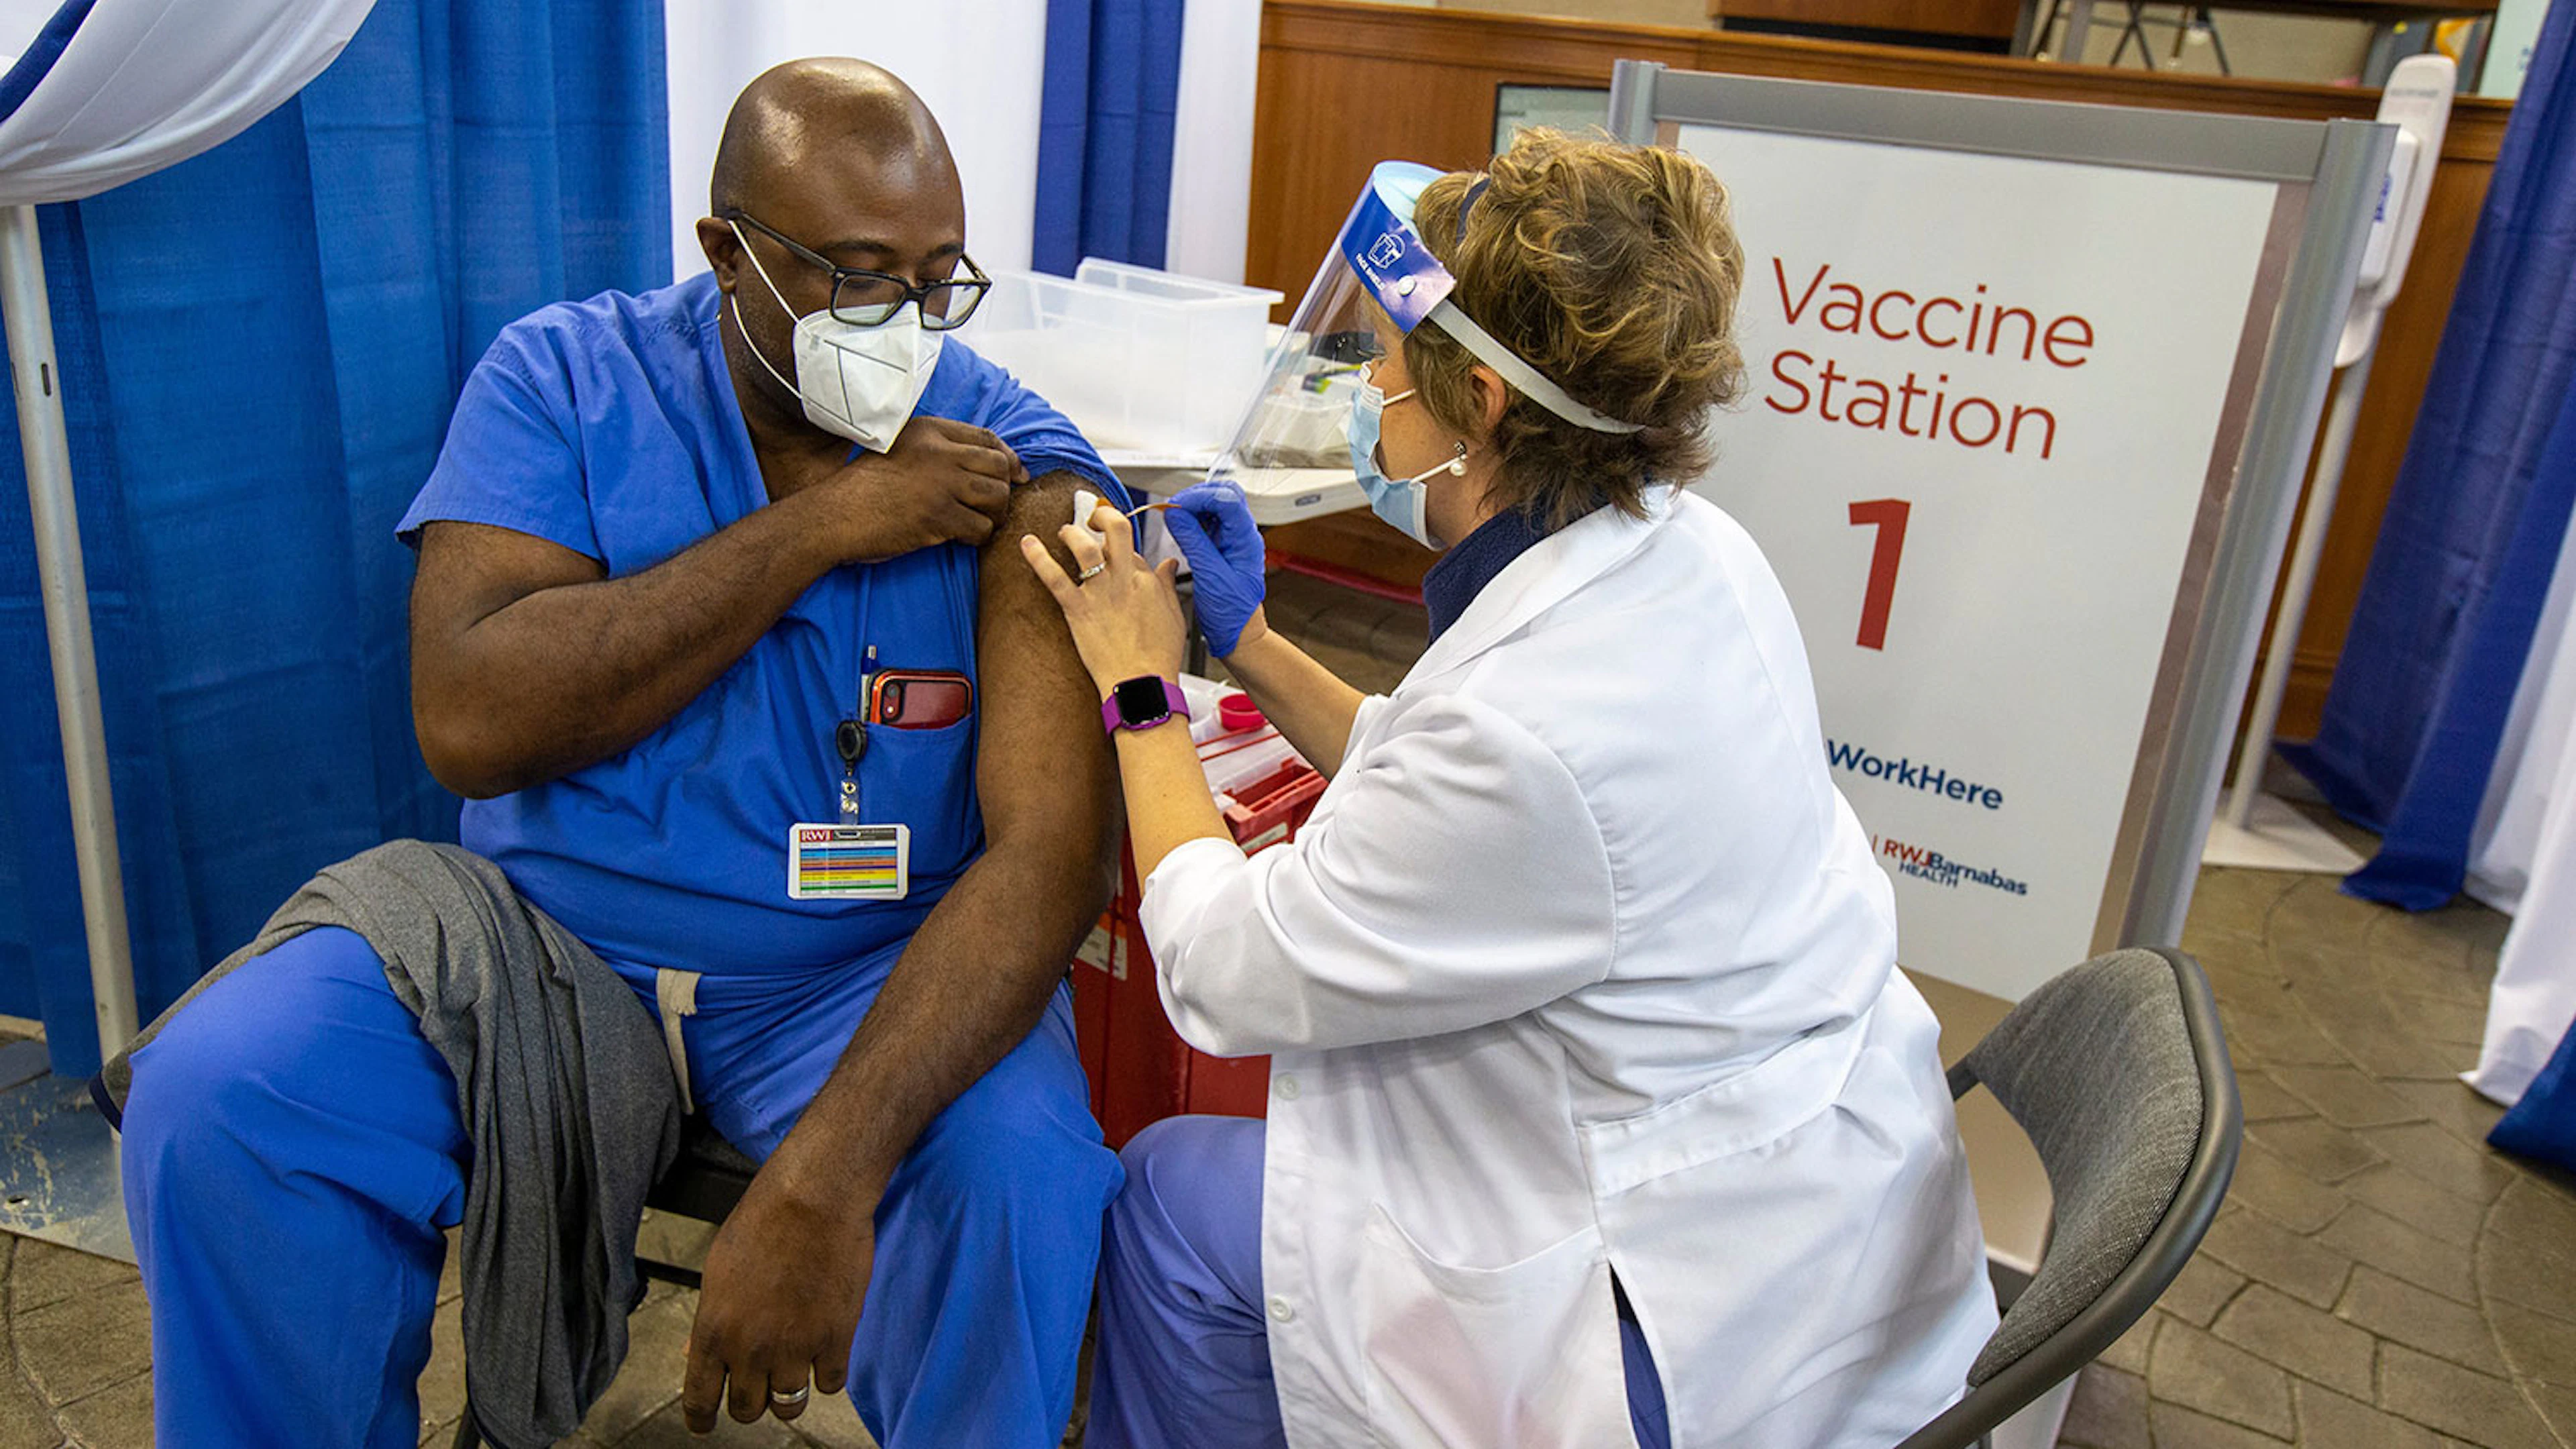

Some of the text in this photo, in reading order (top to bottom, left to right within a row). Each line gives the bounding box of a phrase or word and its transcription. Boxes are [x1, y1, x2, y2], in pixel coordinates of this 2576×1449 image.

[1772, 257, 2094, 368] Vaccine
[1764, 350, 2056, 460] Station
[1848, 498, 1911, 651] 1
[1827, 739, 2004, 810] WorkHere
[1899, 861, 1958, 888] HEALTH
